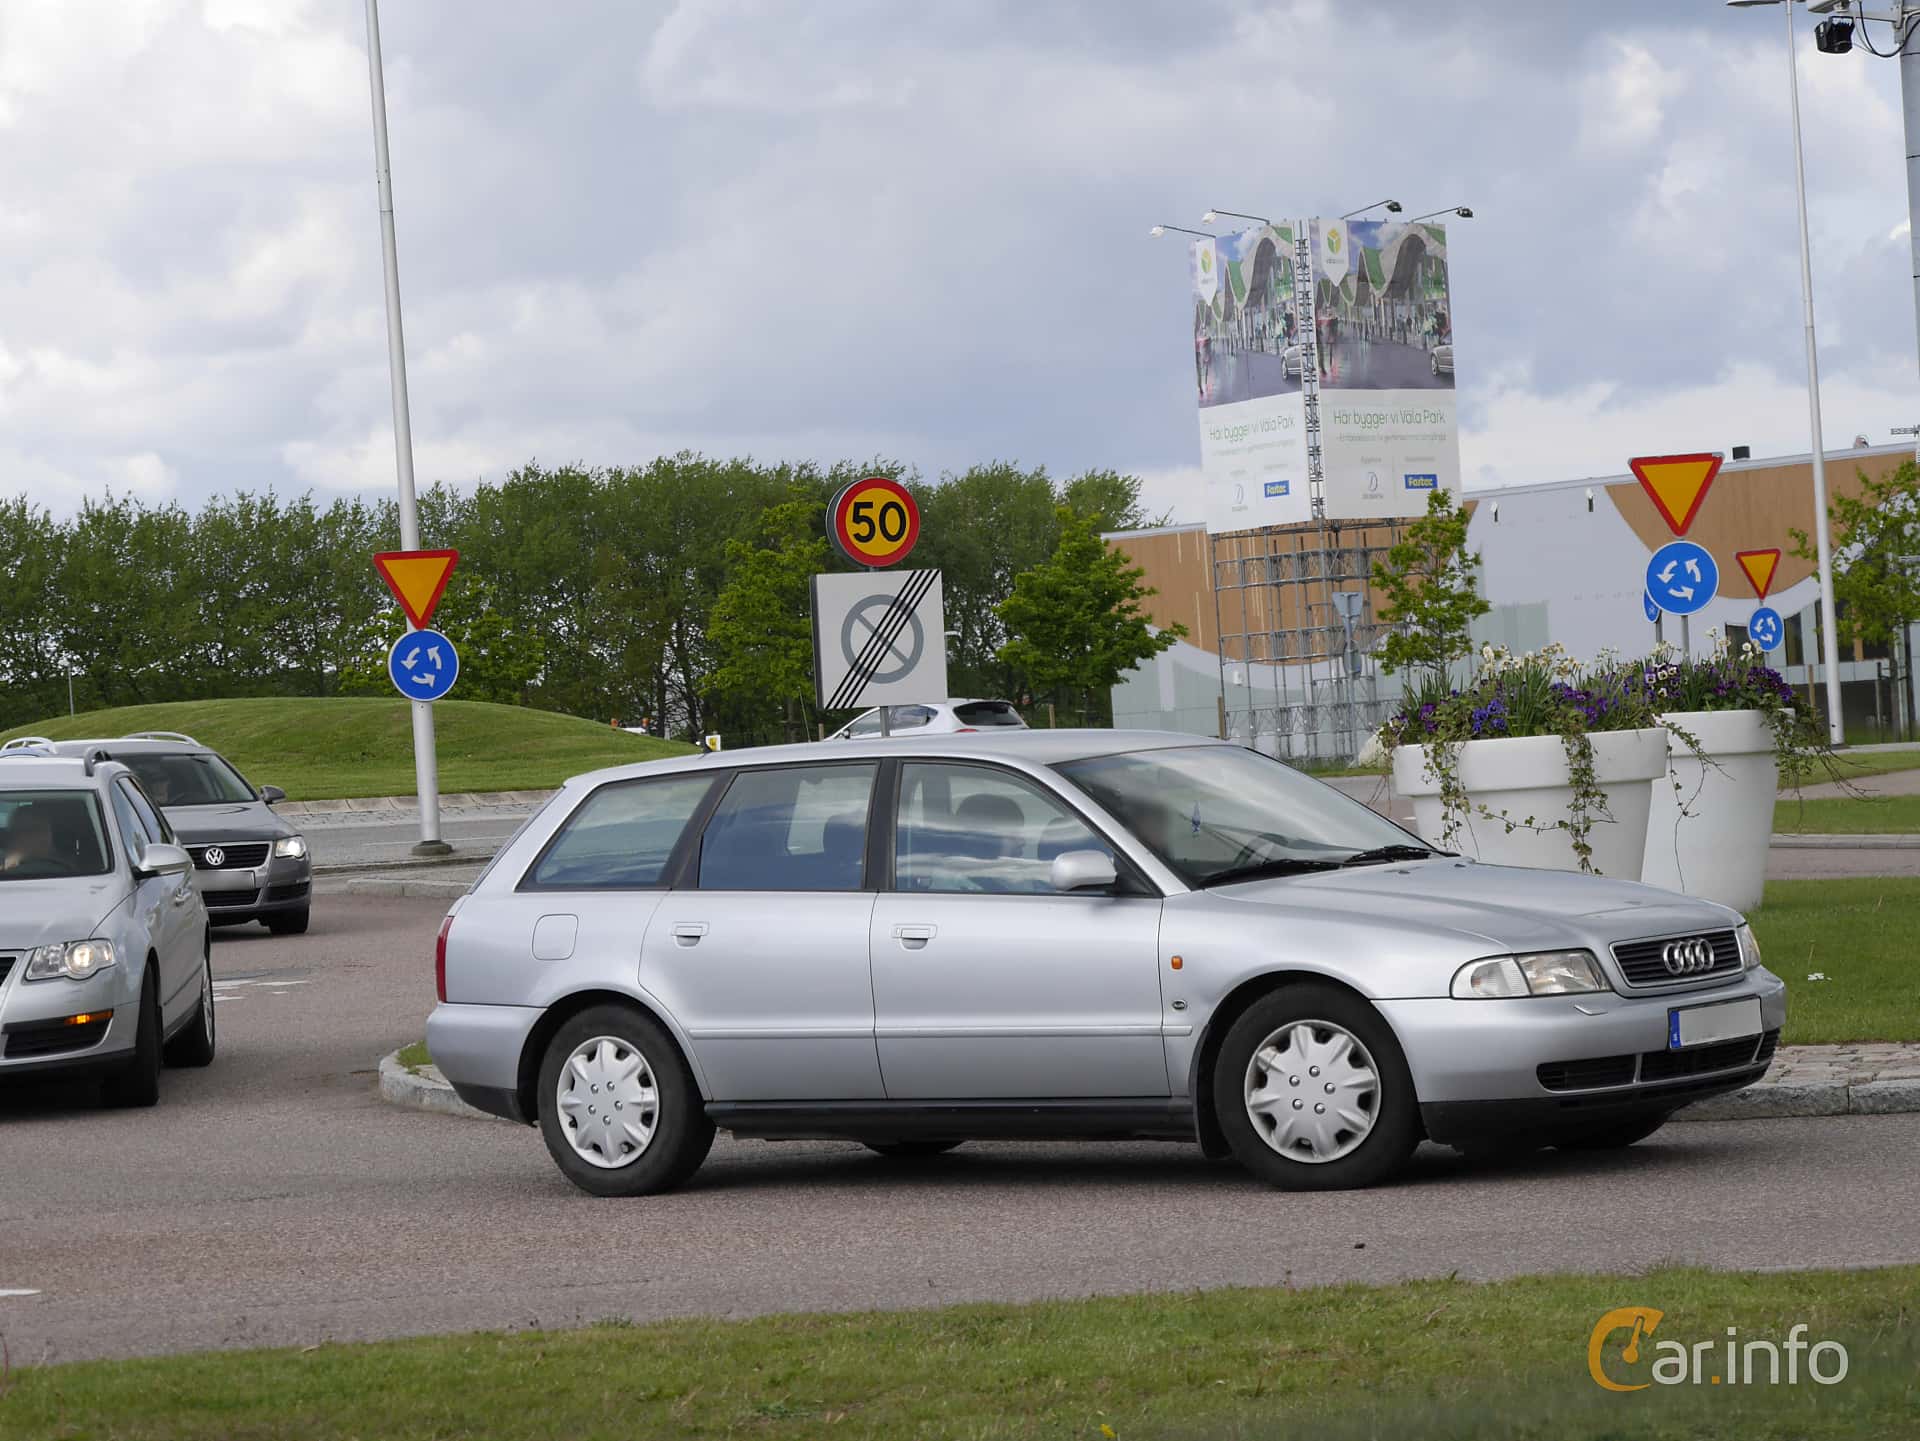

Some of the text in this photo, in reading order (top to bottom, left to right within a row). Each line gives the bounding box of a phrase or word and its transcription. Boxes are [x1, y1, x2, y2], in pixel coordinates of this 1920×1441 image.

[1277, 414, 1296, 430] Park
[1353, 408, 1389, 429] bygger
[1391, 410, 1399, 424] vi
[1423, 408, 1446, 424] Park
[852, 501, 907, 543] 50
